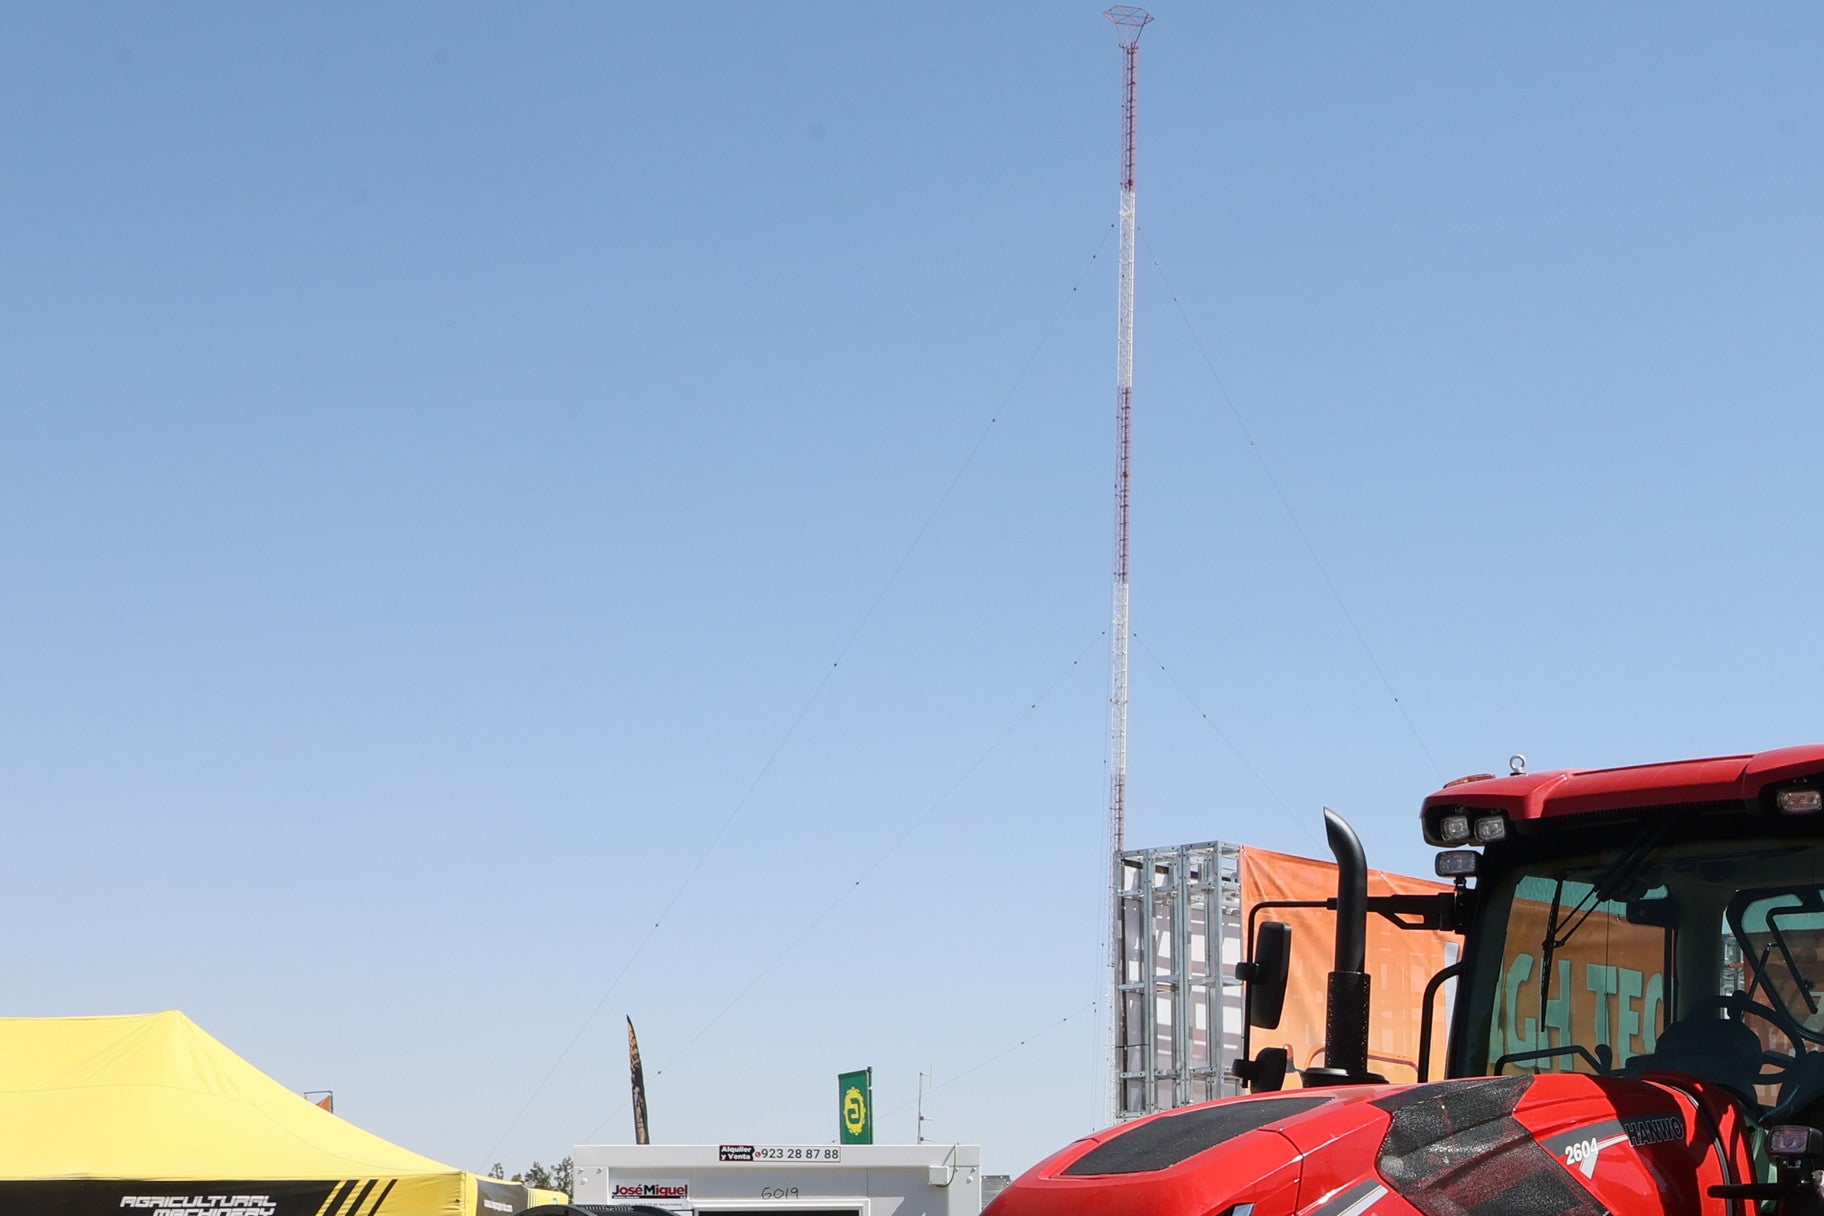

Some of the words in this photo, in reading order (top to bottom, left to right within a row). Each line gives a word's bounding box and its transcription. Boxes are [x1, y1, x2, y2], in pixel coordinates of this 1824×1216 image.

[1624, 1116, 1685, 1147] HANWO
[721, 1146, 752, 1154] Alquiler
[762, 1148, 783, 1159] 923
[787, 1149, 802, 1159] 28
[806, 1149, 820, 1159] 87
[824, 1149, 839, 1159] 88
[1565, 1137, 1599, 1165] 2604
[120, 1195, 277, 1208] AGRICULTURAL
